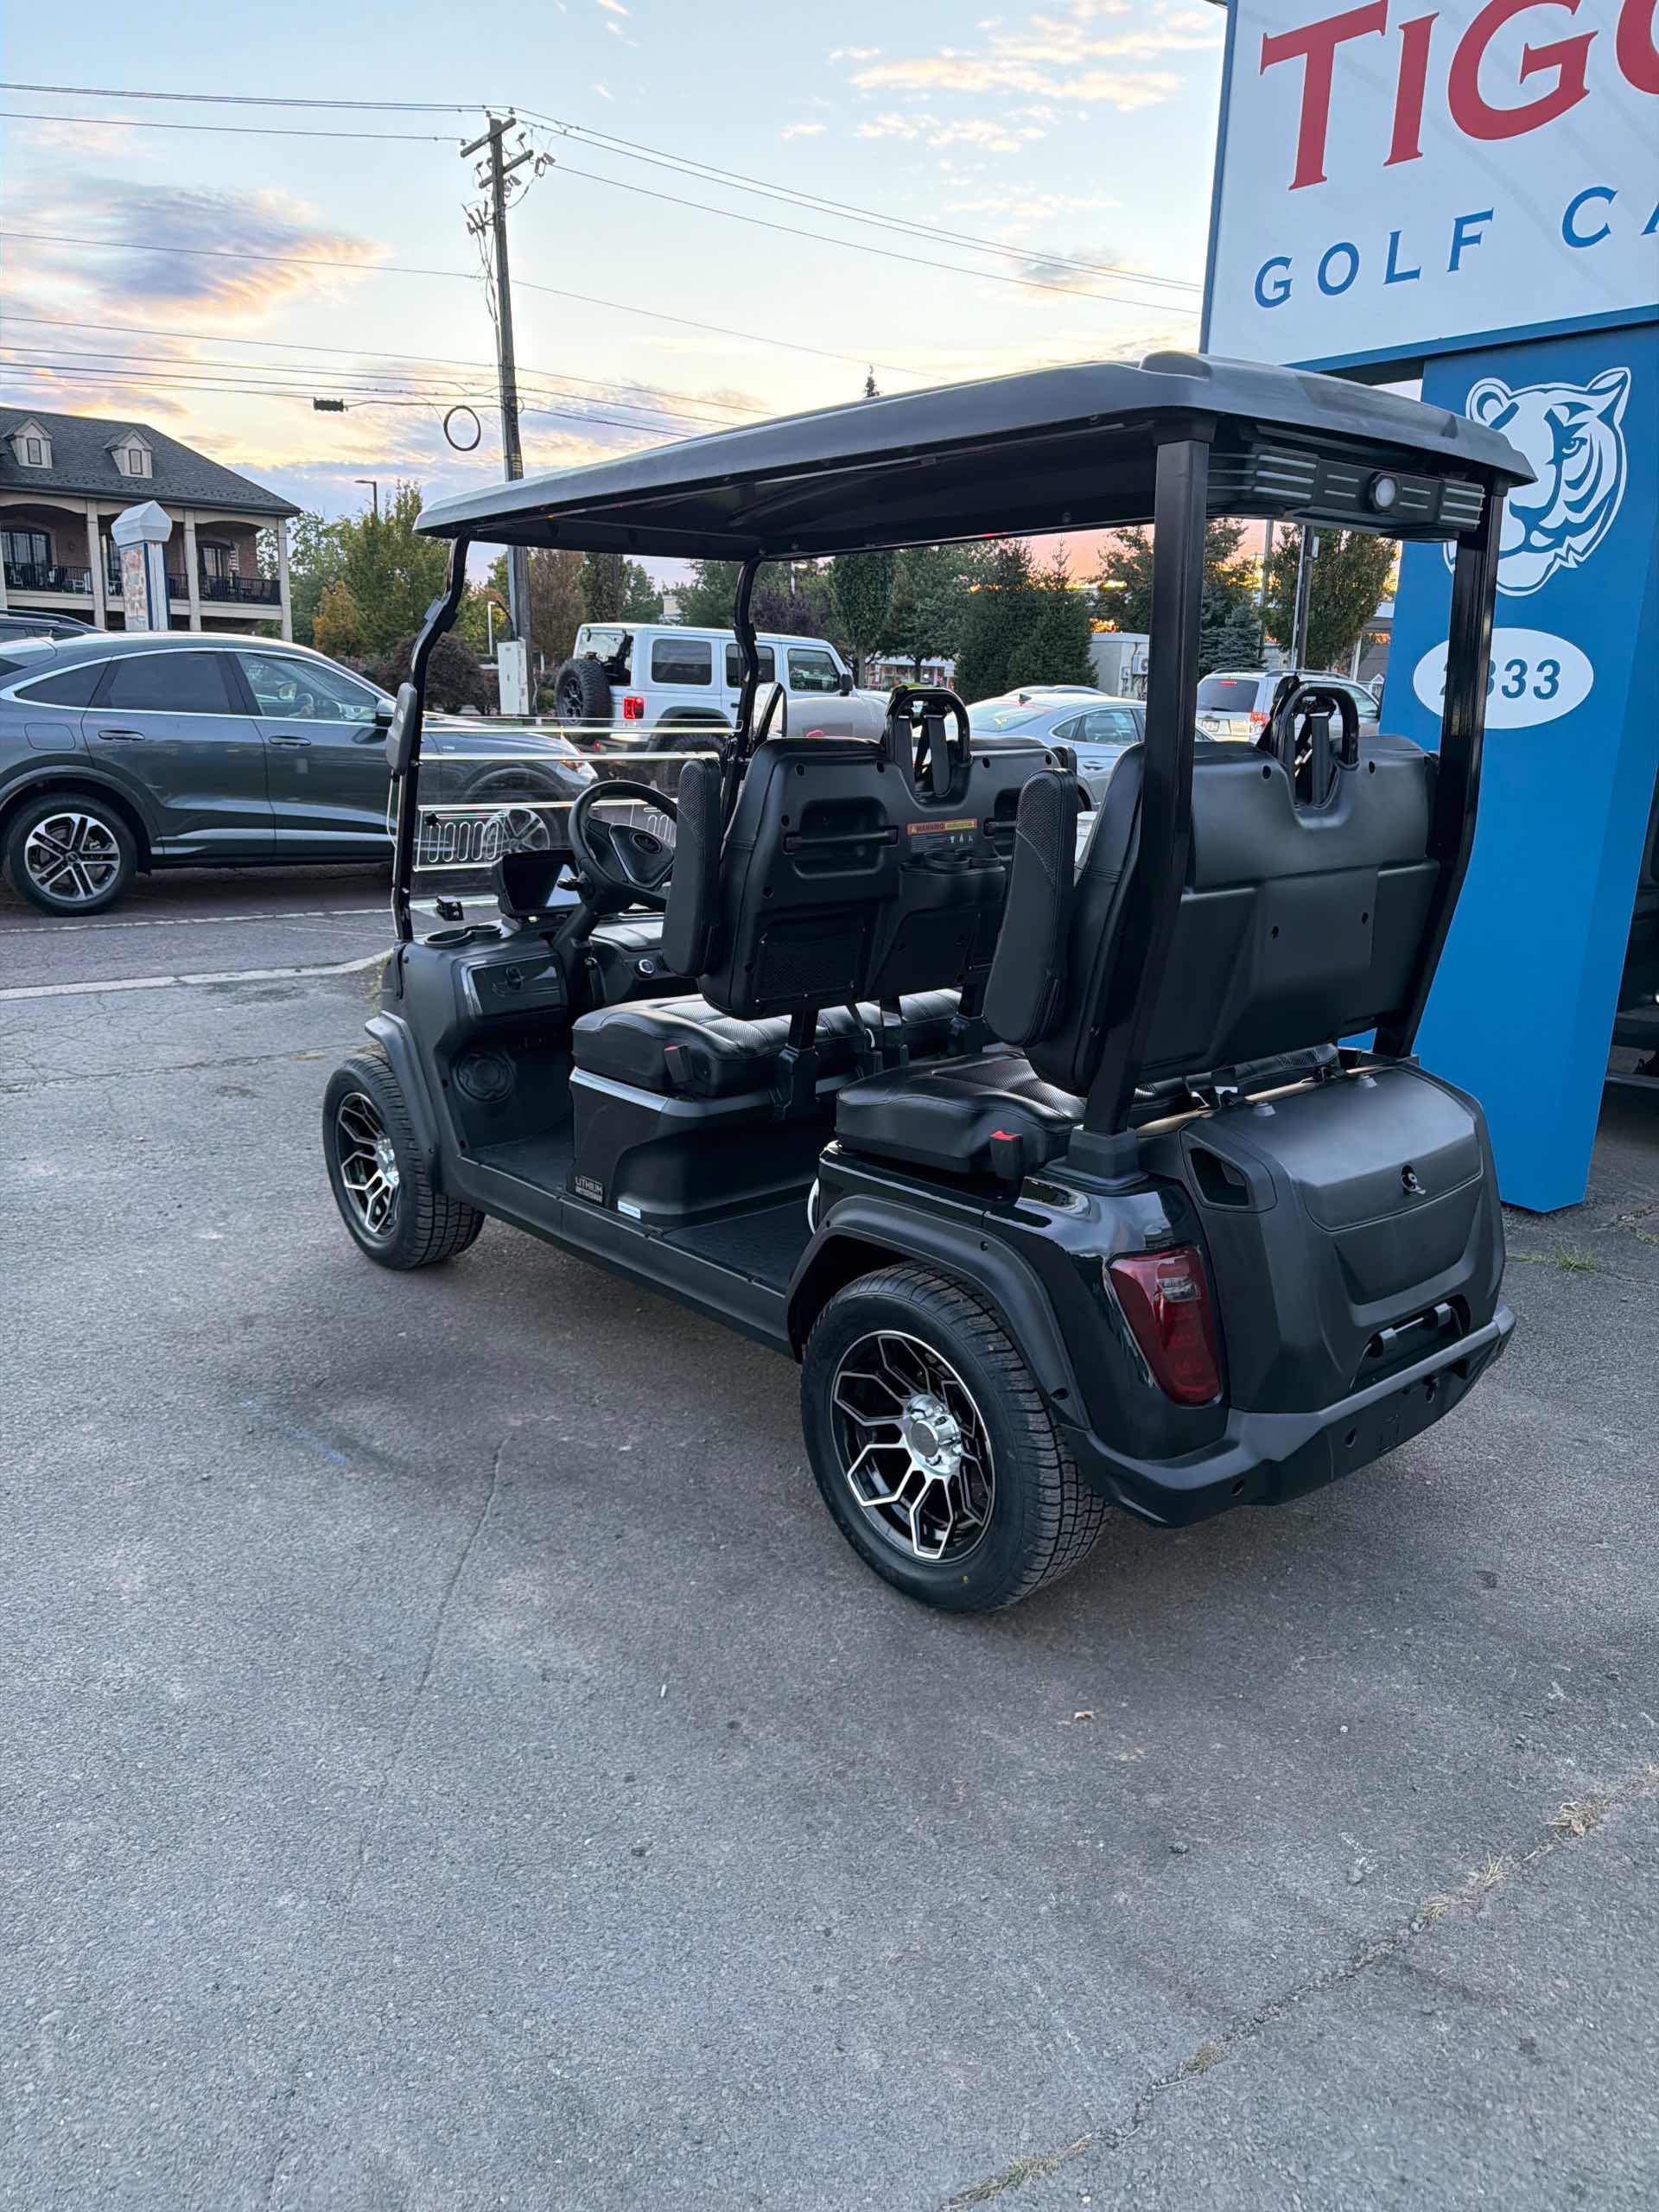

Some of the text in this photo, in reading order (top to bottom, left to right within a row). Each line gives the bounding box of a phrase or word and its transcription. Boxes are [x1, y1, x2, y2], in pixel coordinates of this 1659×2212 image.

[1254, 207, 1494, 308] GOLF
[1440, 658, 1561, 700] 33
[575, 1175, 603, 1195] LITHIUM
